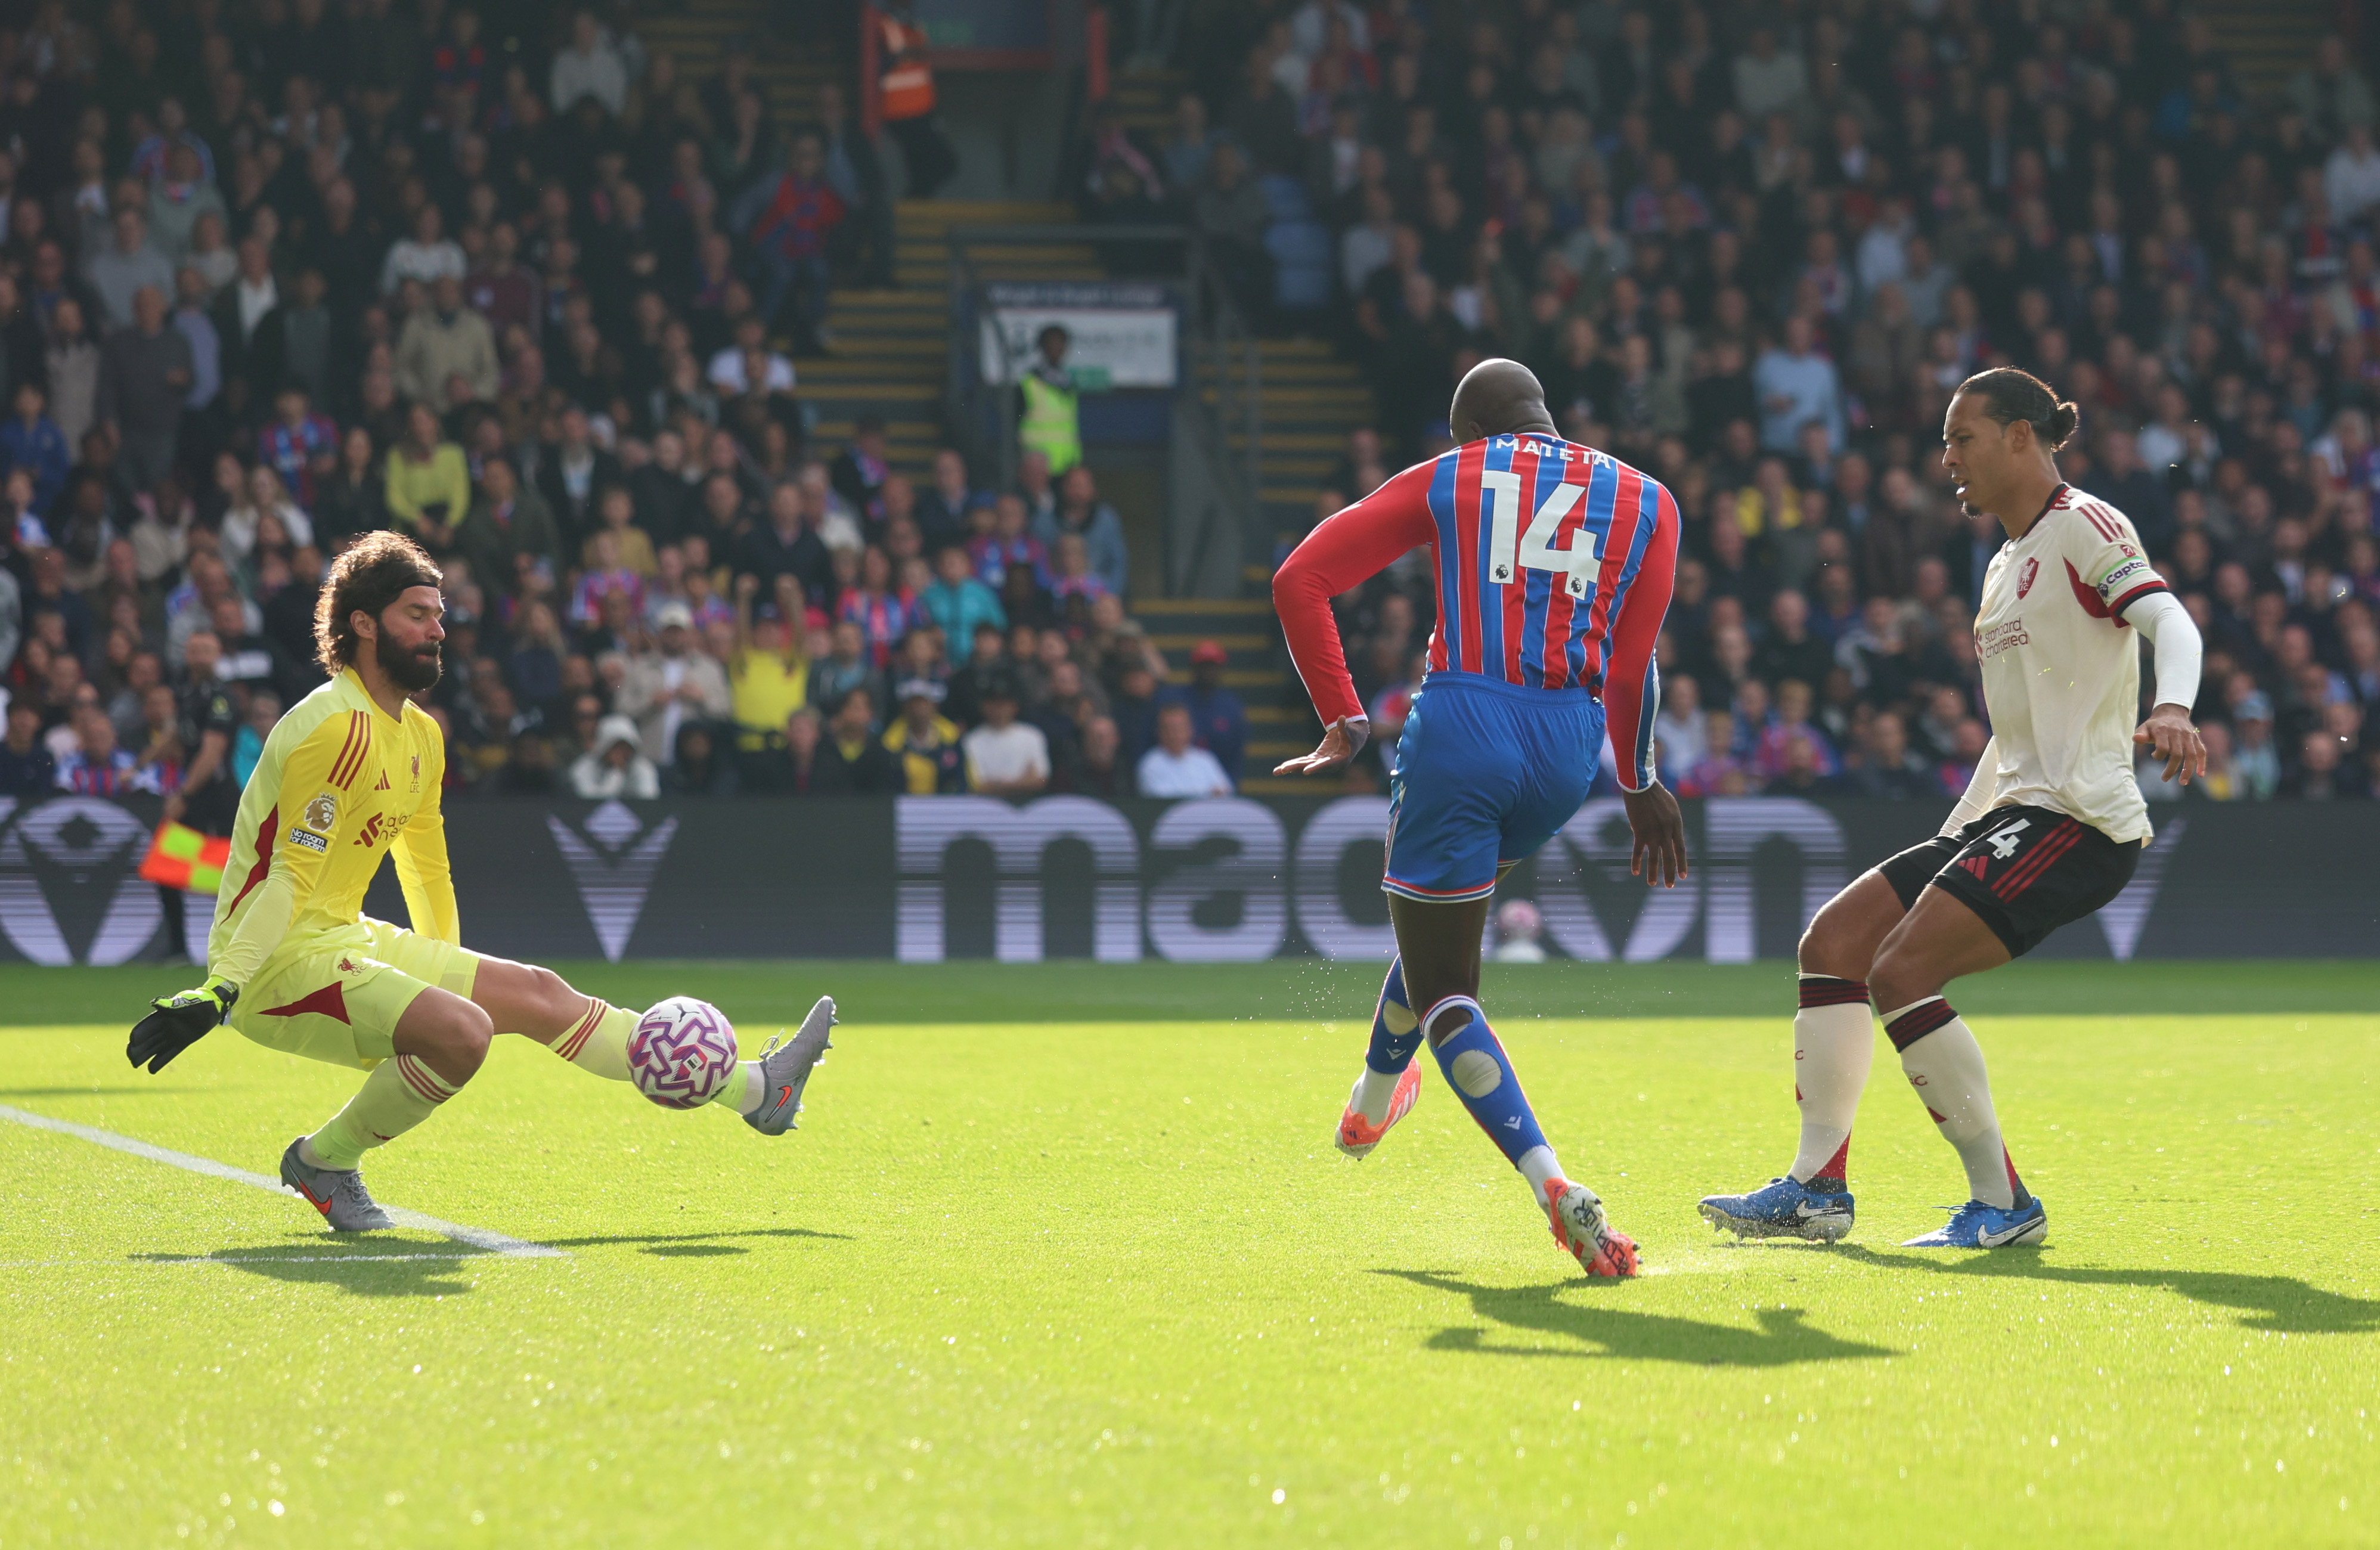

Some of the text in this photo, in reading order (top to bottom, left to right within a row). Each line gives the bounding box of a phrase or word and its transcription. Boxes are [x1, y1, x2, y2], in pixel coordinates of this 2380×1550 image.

[1496, 438, 1611, 469] MATETA
[1481, 470, 1602, 600] 14
[1985, 617, 2021, 644] standard
[1985, 631, 2028, 658] chartered
[290, 828, 324, 846] No room
[300, 839, 326, 853] racism
[1987, 818, 2032, 859] 4
[895, 795, 1846, 963] macon
